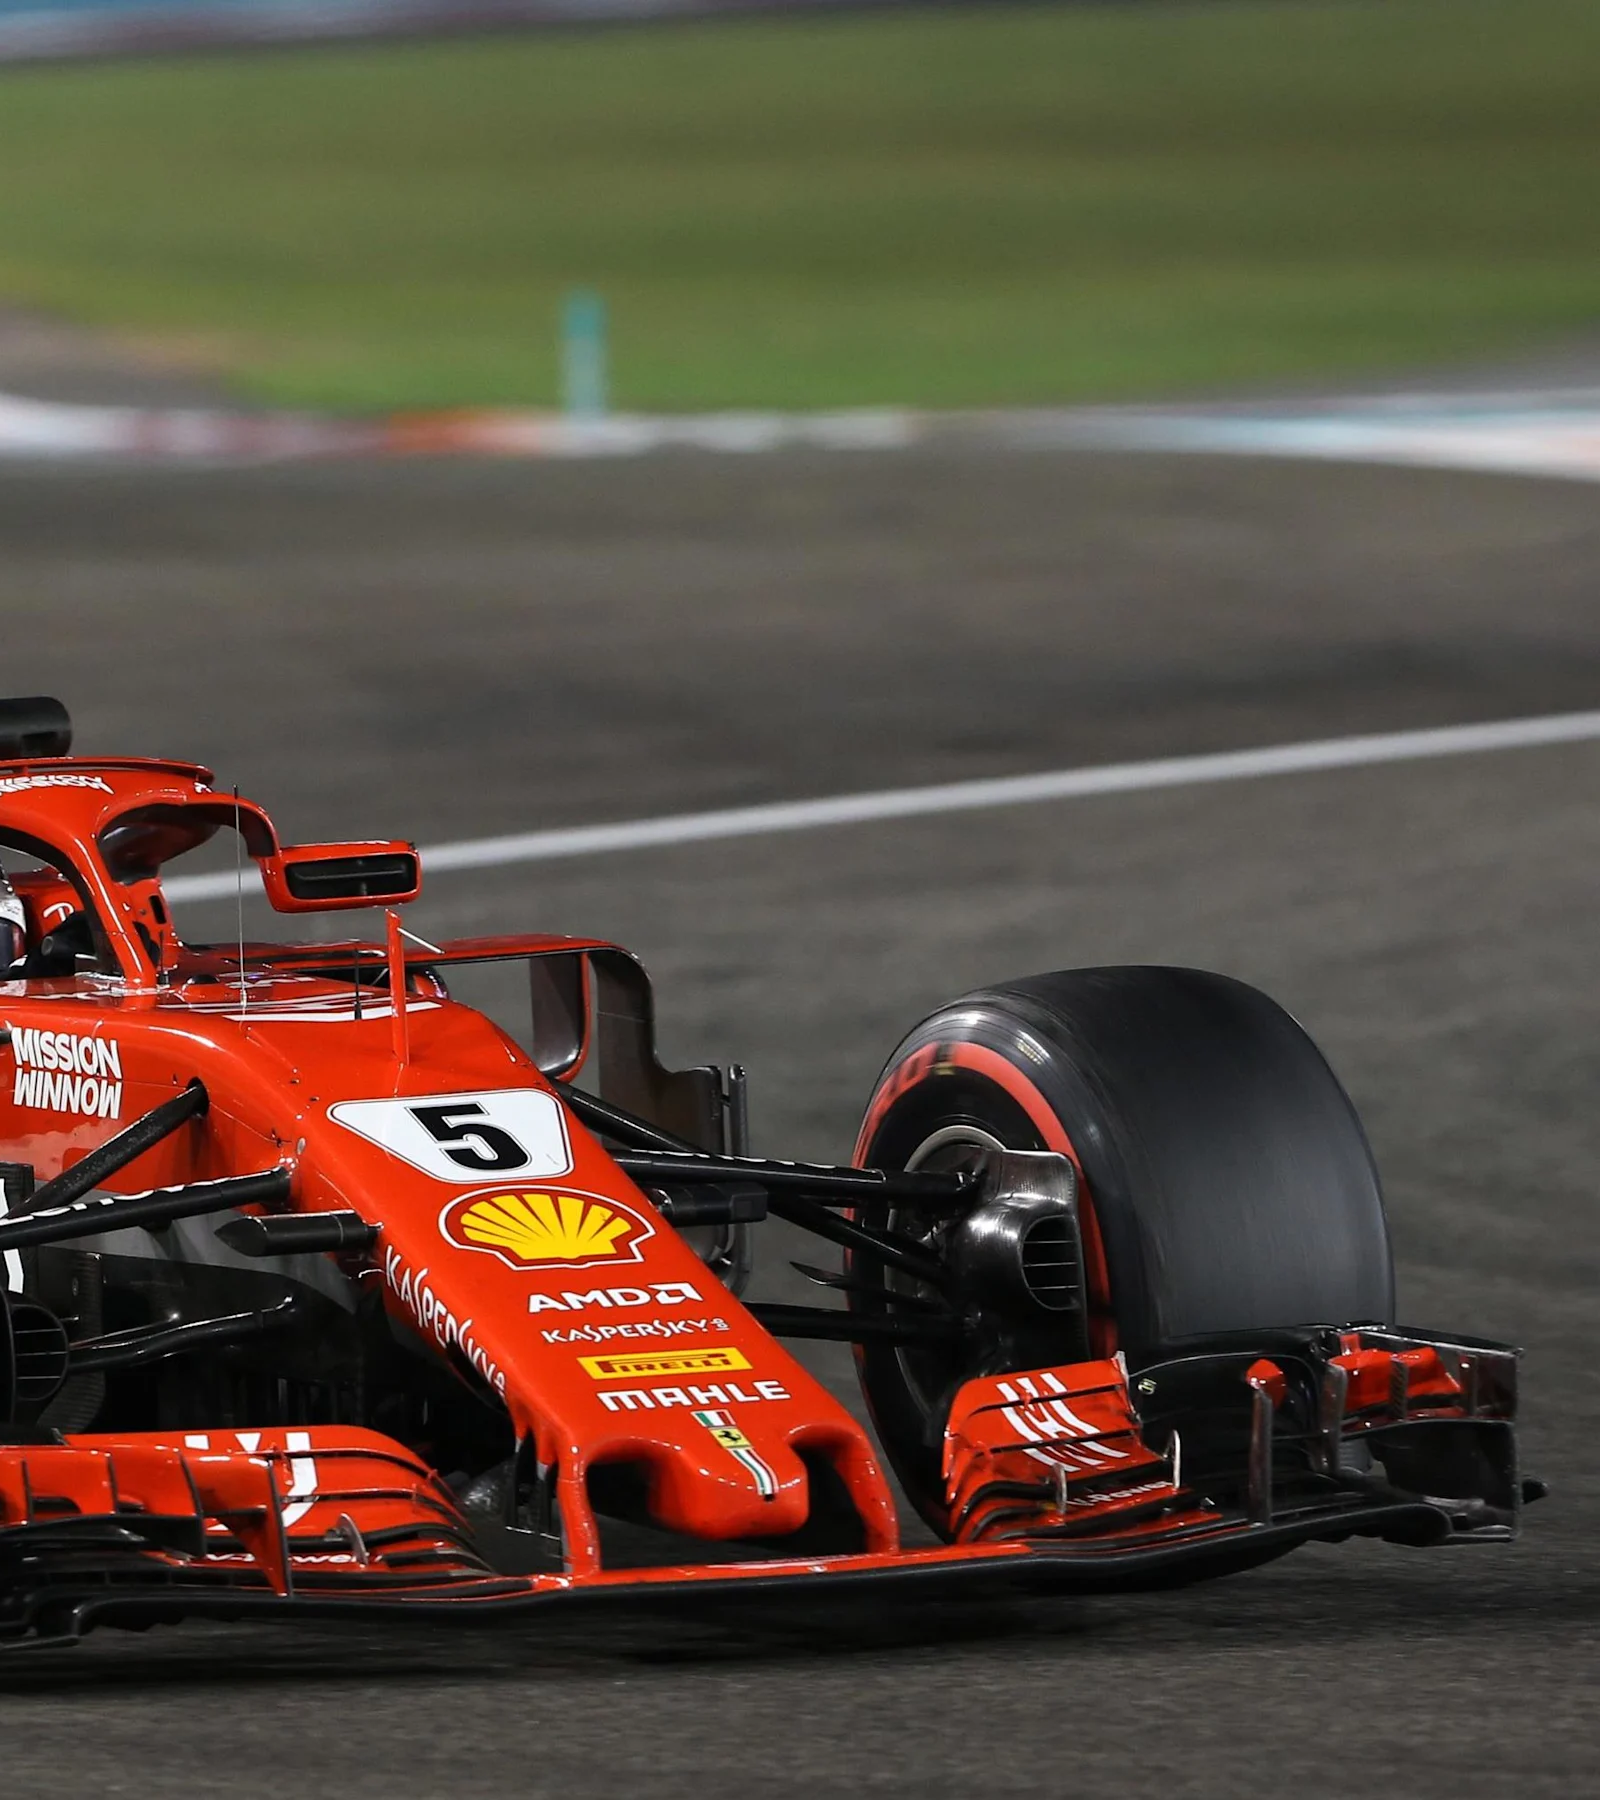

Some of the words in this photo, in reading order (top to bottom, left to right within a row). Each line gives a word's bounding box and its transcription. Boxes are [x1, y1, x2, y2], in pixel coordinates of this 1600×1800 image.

[11, 1027, 122, 1079] MISSION
[13, 1067, 122, 1119] WINNOW
[409, 1103, 530, 1170] 5
[528, 1287, 651, 1313] AMD
[540, 1318, 708, 1343] KASPERSKY
[595, 1352, 732, 1374] PIRELLI
[596, 1380, 791, 1411] MAHLE
